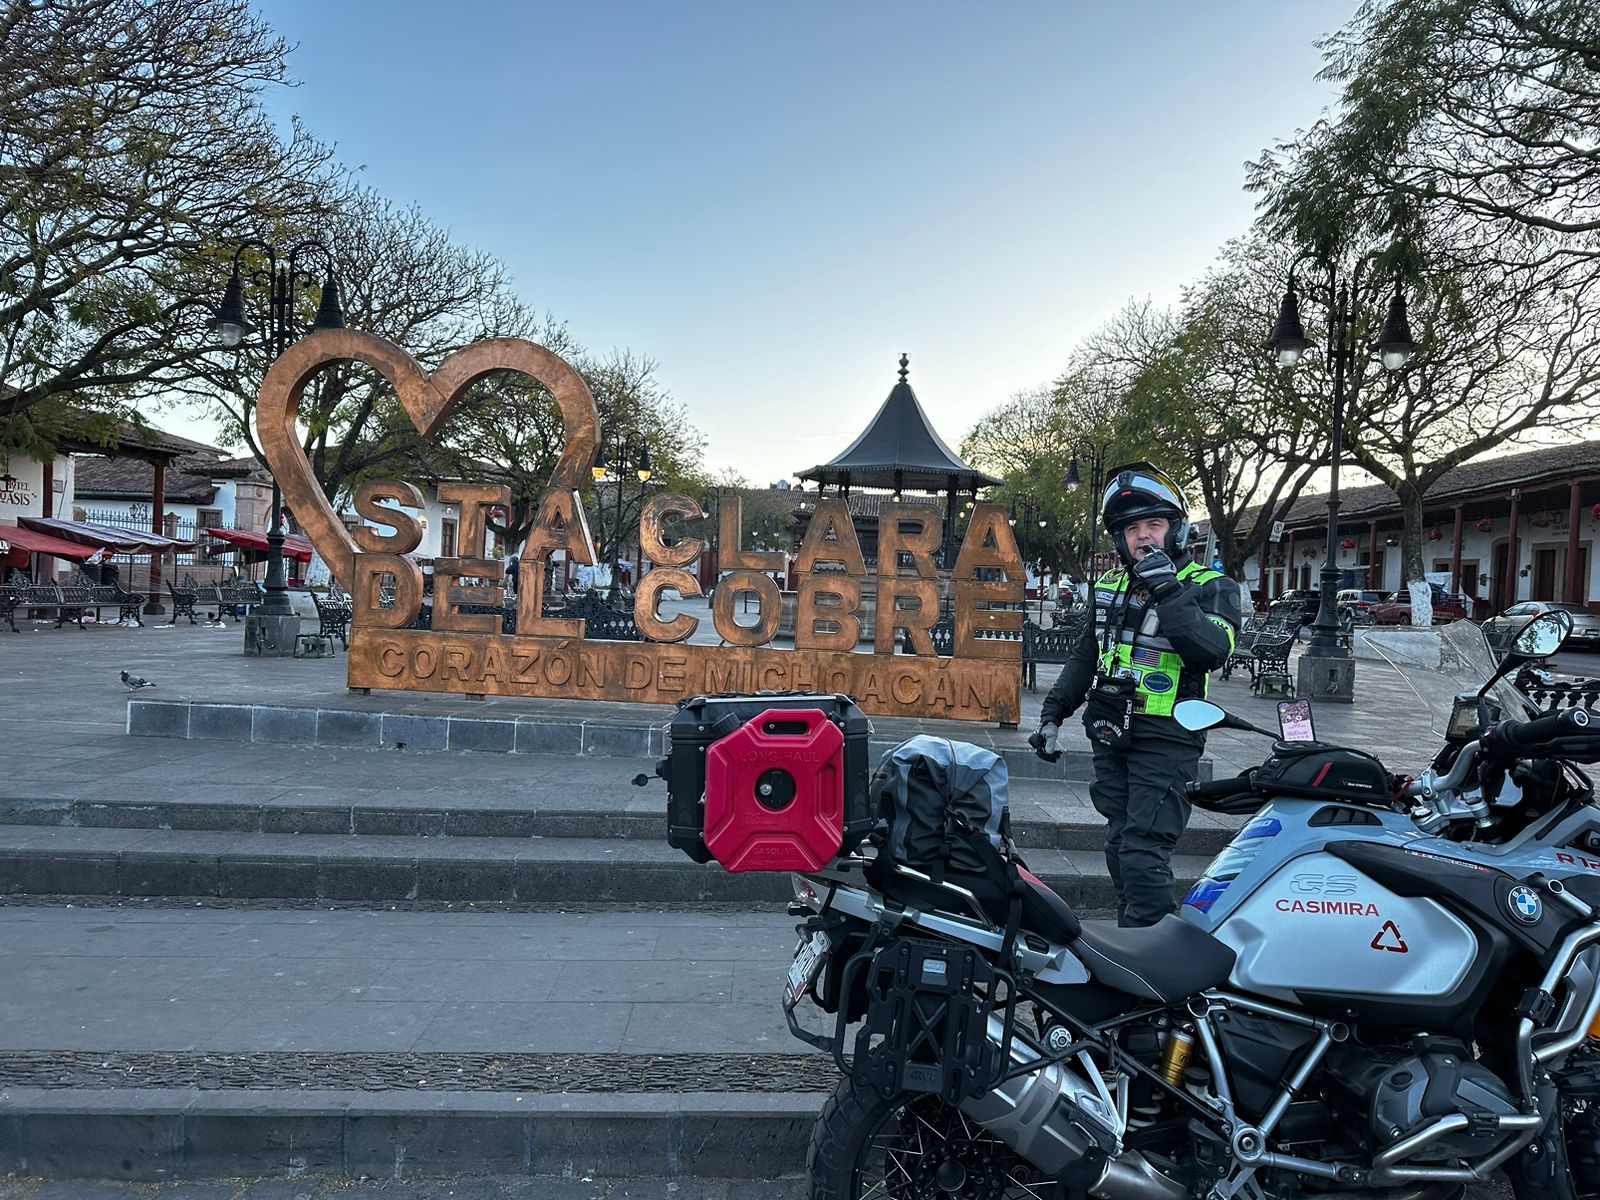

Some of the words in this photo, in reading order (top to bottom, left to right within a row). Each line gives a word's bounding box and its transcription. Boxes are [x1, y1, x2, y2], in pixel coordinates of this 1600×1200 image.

[351, 478, 598, 566] STA
[639, 492, 1028, 583] CLARA
[354, 553, 586, 640] DEL
[634, 566, 1025, 660] COBRE
[375, 640, 607, 689] CORAZÓN
[625, 653, 688, 693] DE
[703, 657, 993, 708] MICHOACÁN
[1275, 898, 1381, 917] CASIMIRA
[1289, 873, 1359, 897] GS
